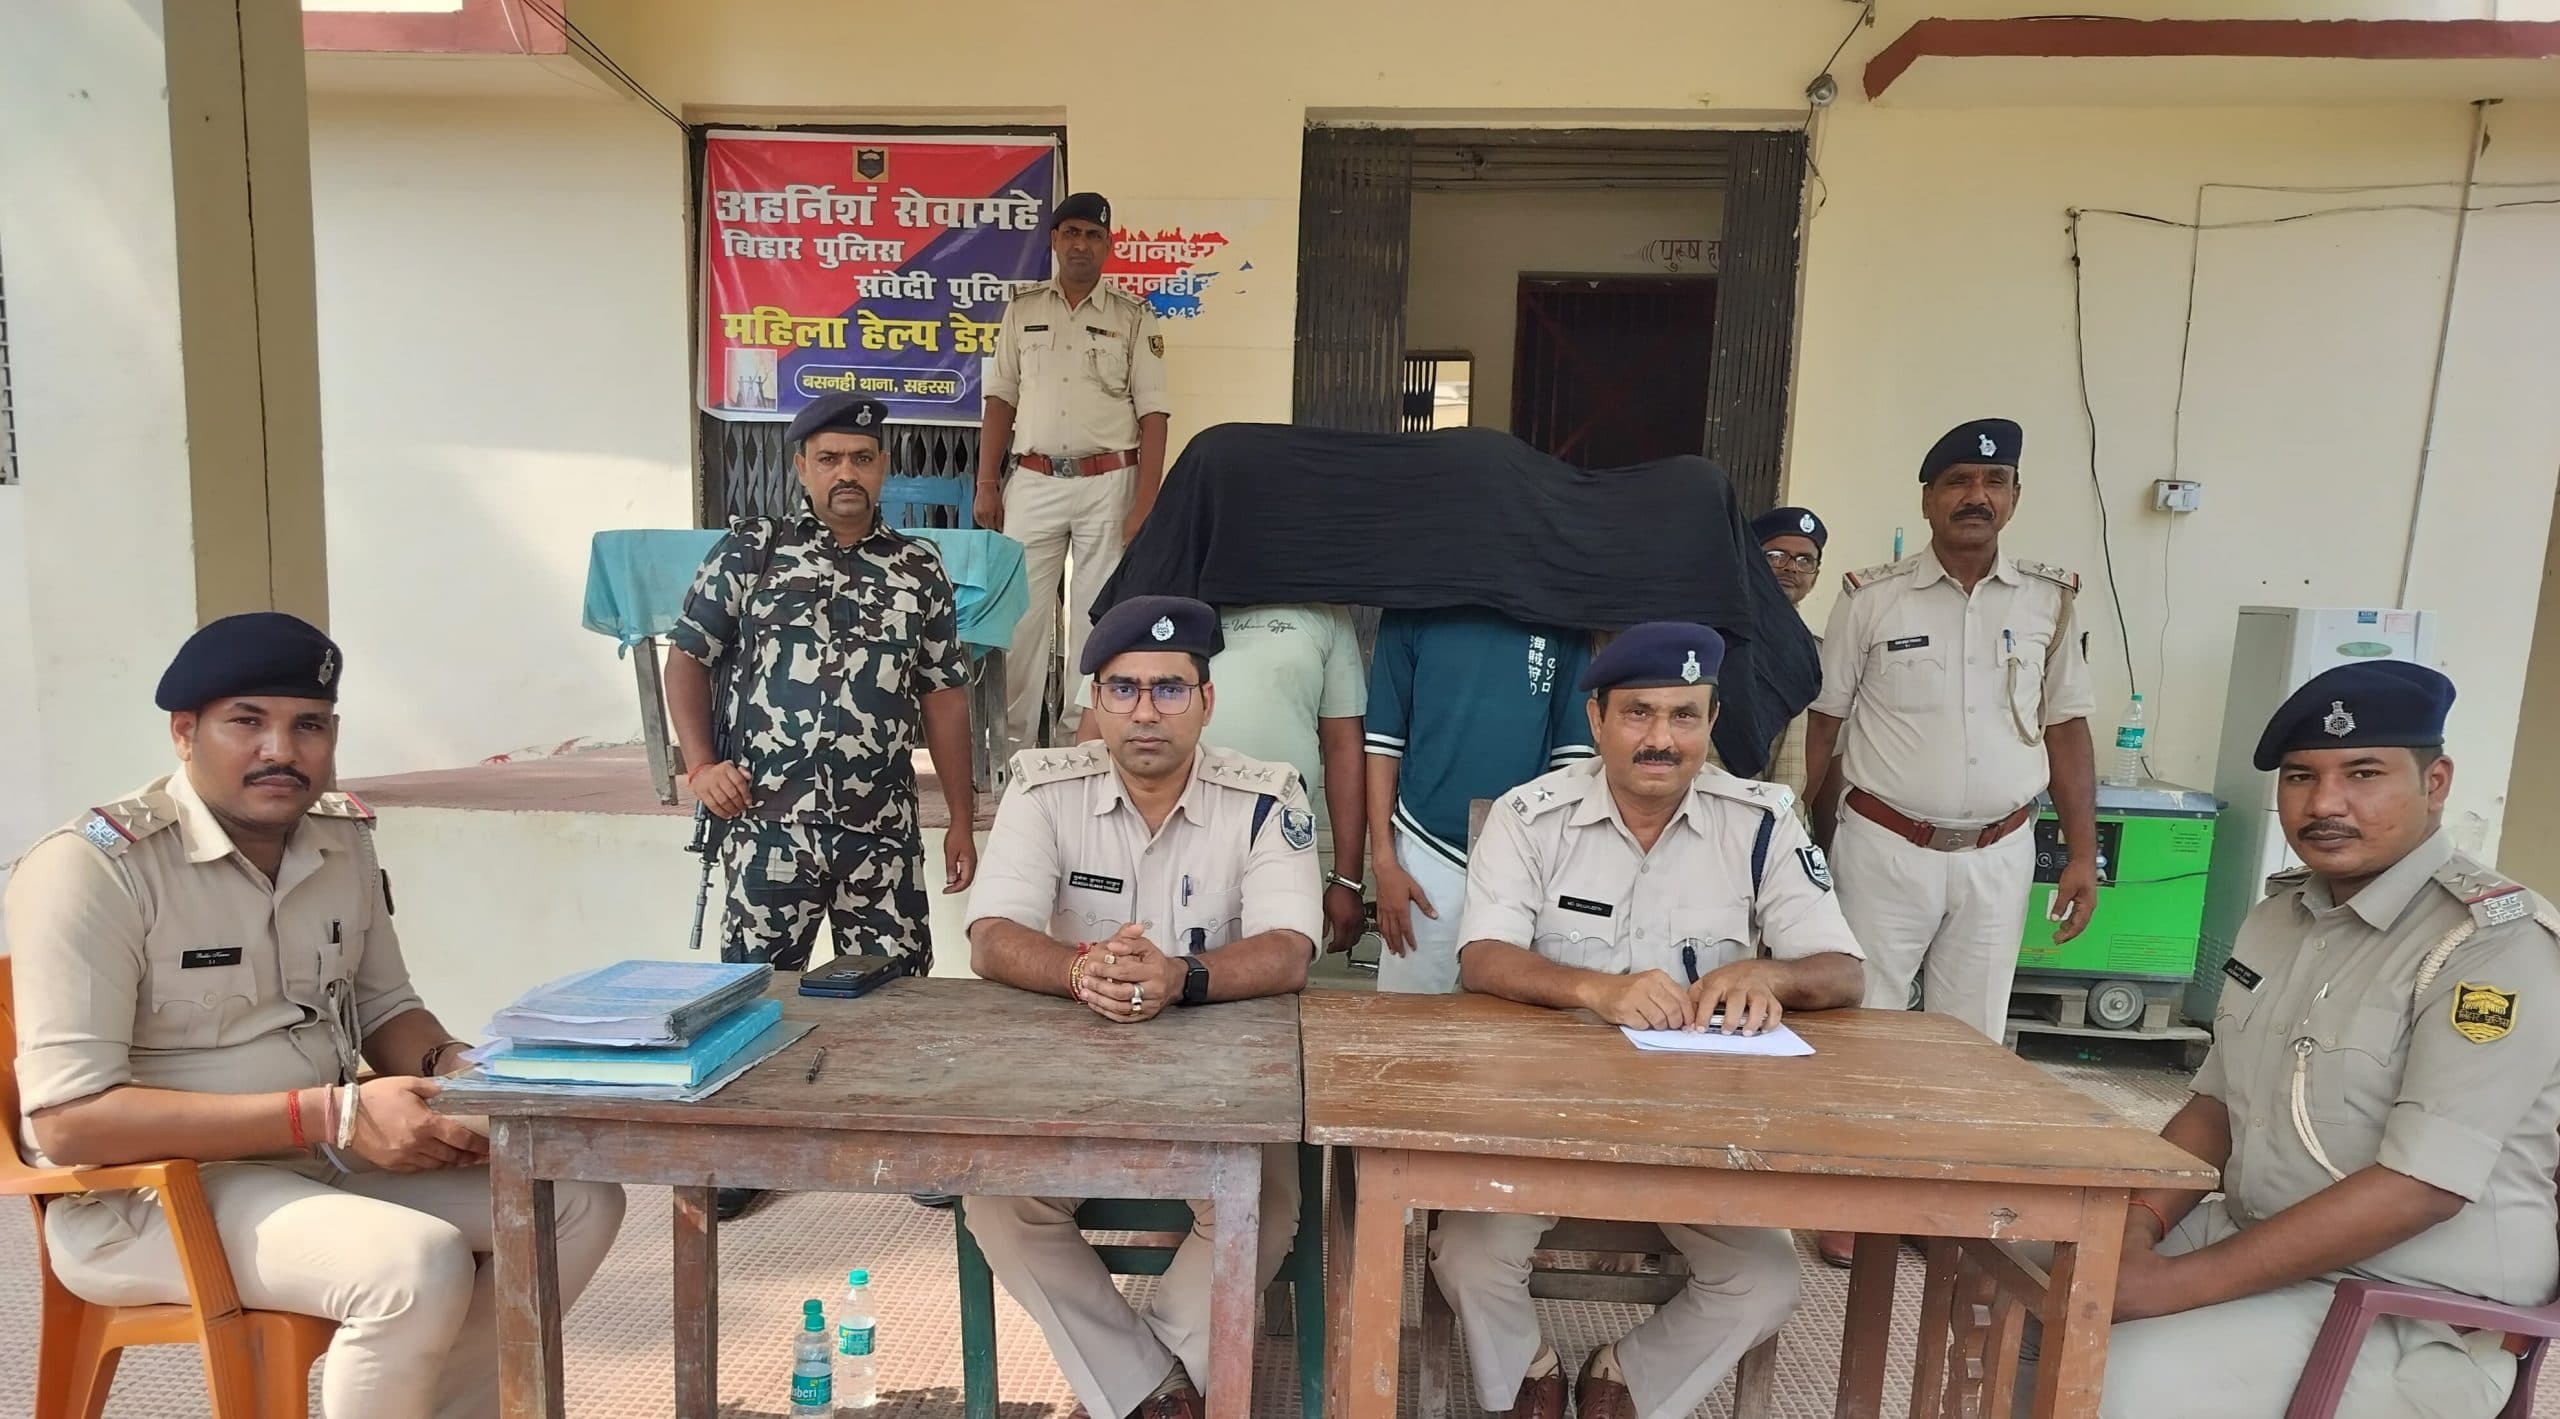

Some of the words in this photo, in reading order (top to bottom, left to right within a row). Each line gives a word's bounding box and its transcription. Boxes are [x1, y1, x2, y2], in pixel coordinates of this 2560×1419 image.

[716, 185, 878, 227] अहर्निशं
[892, 188, 1043, 230] सेवामहे
[722, 230, 803, 261] बिहार
[814, 234, 905, 267] पुलिस
[854, 269, 937, 301] संवेदी
[947, 273, 1036, 309] पुलि
[720, 306, 849, 349] महिला
[859, 310, 941, 352] हेल्प
[802, 371, 857, 393] बसनही
[860, 374, 898, 393] थाना,
[904, 379, 955, 395] सहरसा
